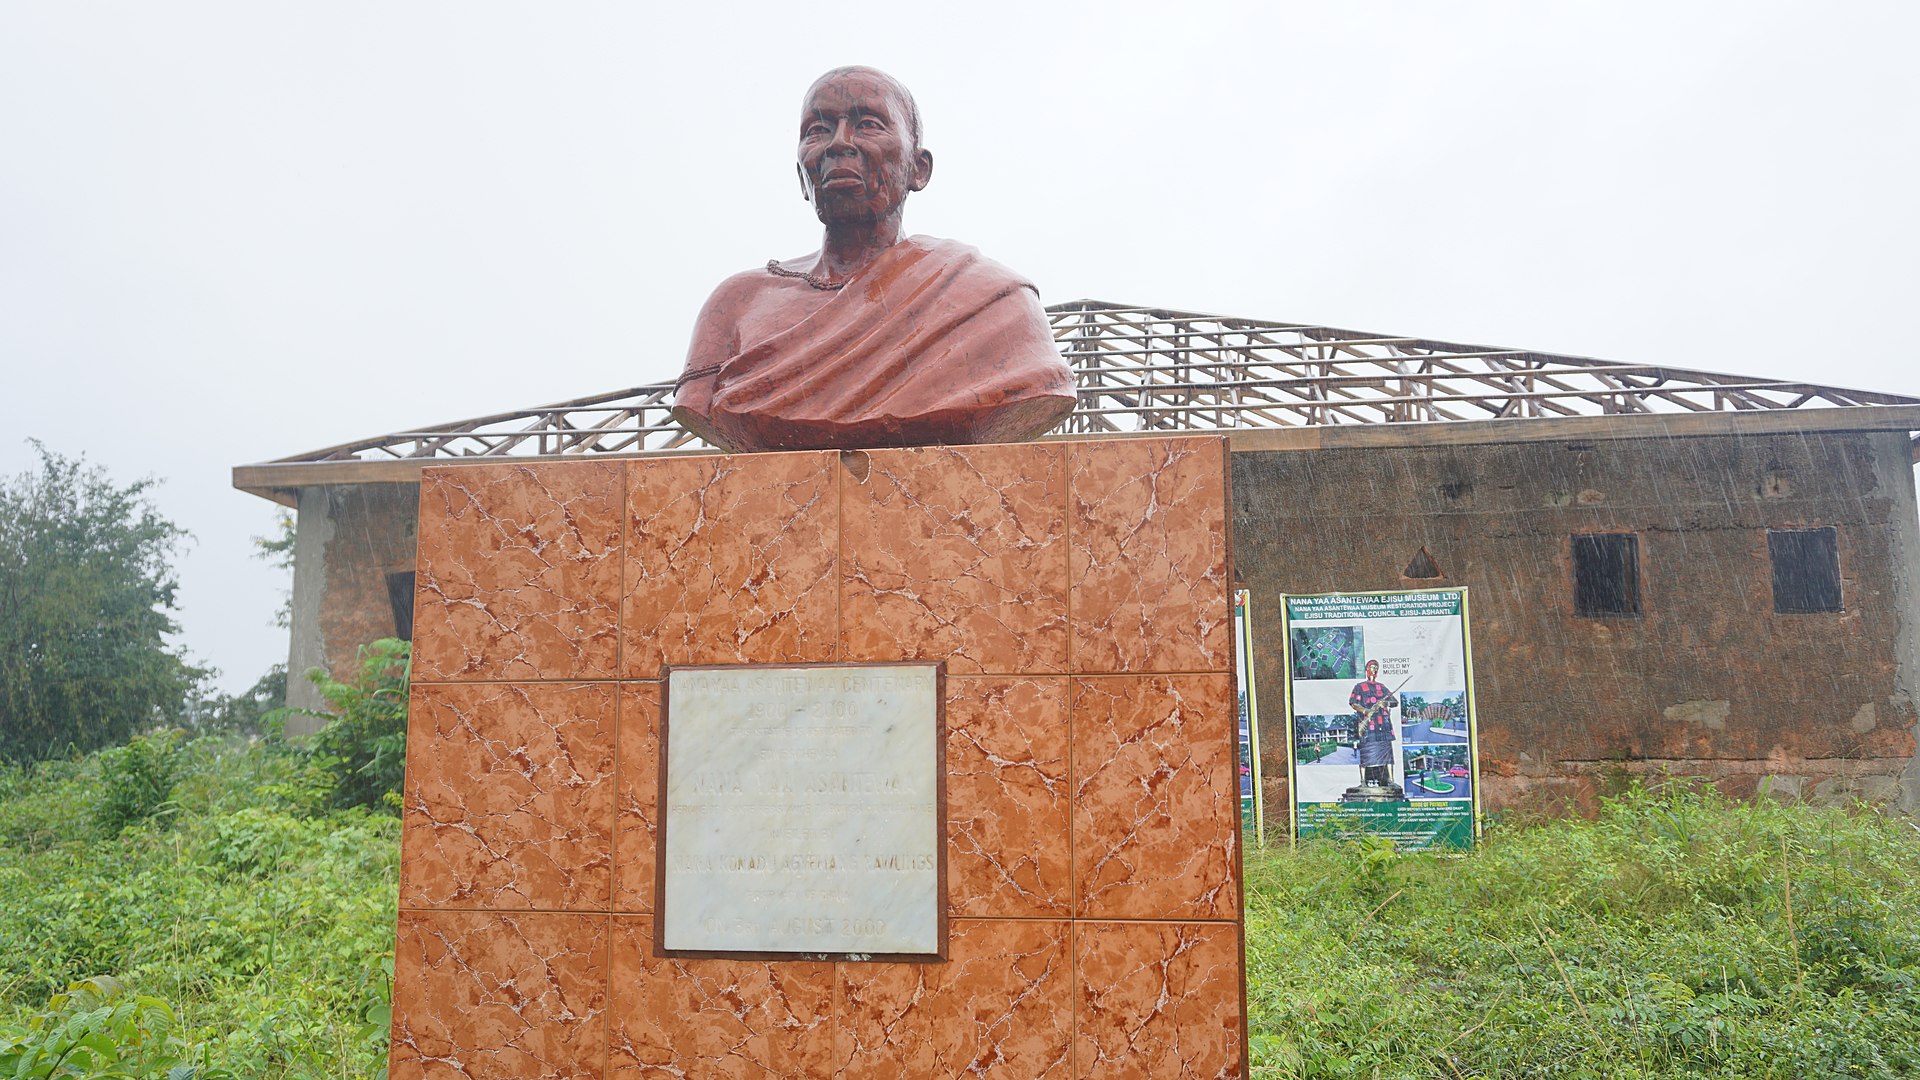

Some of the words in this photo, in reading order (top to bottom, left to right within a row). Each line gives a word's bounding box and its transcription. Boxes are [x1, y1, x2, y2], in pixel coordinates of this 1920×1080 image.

[1314, 597, 1329, 605] YAA
[1331, 596, 1379, 604] ASANTEWAA
[1381, 595, 1403, 604] EJISU
[1405, 594, 1439, 602] MUSEUM
[1443, 593, 1460, 601] LTD.
[1324, 611, 1366, 619] TRADITIONAL
[842, 675, 932, 693] CENTENARY
[812, 700, 858, 720] 2000
[693, 770, 743, 795] NANA
[804, 770, 917, 795] ASANTEWAA
[863, 854, 934, 872] RAWLINGS
[768, 917, 834, 936] AUGUST
[839, 918, 888, 937] 2000
